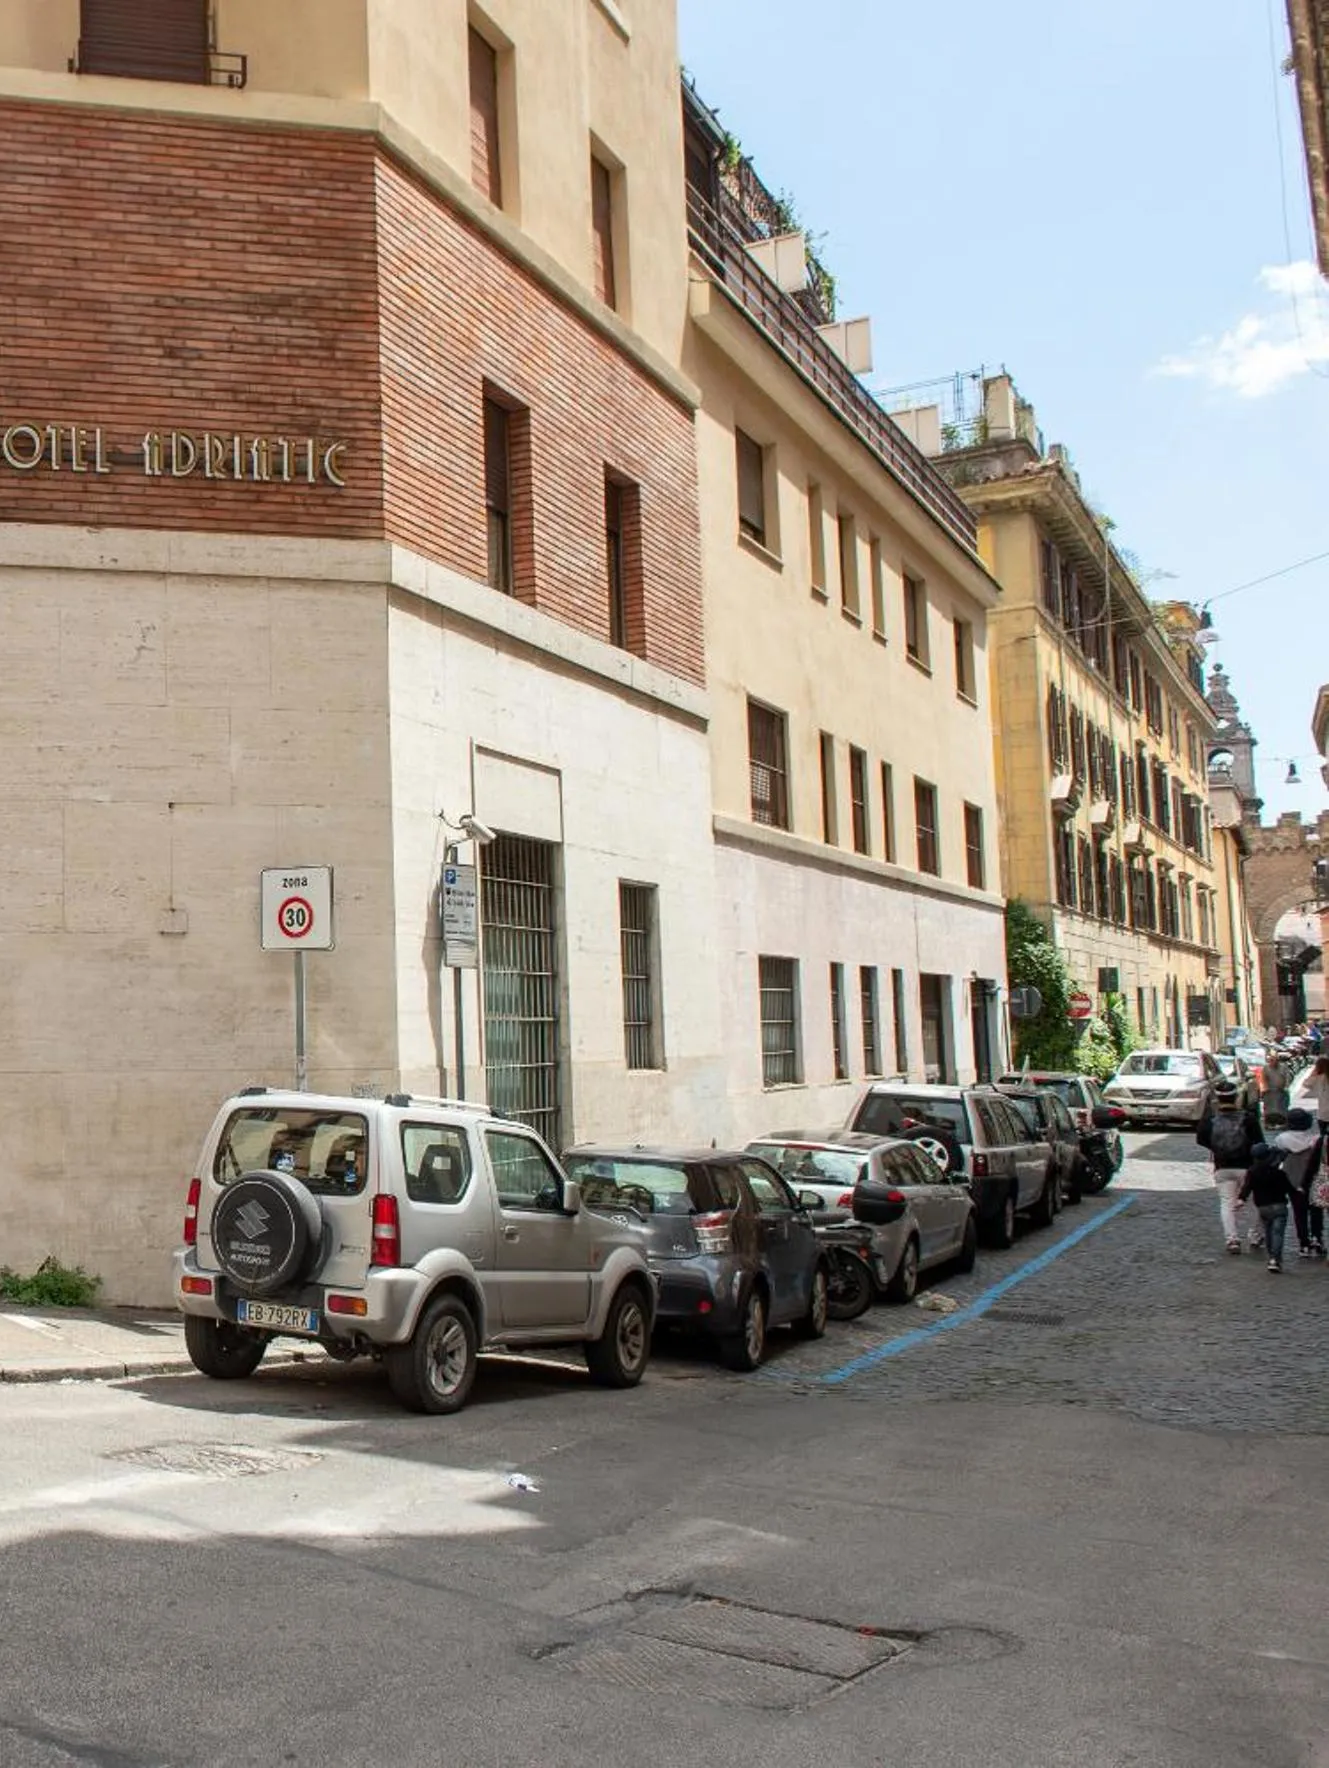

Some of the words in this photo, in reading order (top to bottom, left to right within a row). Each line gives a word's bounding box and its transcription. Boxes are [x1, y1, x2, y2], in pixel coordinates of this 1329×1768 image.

[142, 432, 351, 486] ADRIATIC
[283, 877, 308, 888] zona
[286, 908, 306, 927] 30
[248, 1302, 264, 1317] EB
[270, 1306, 309, 1329] 792RX
